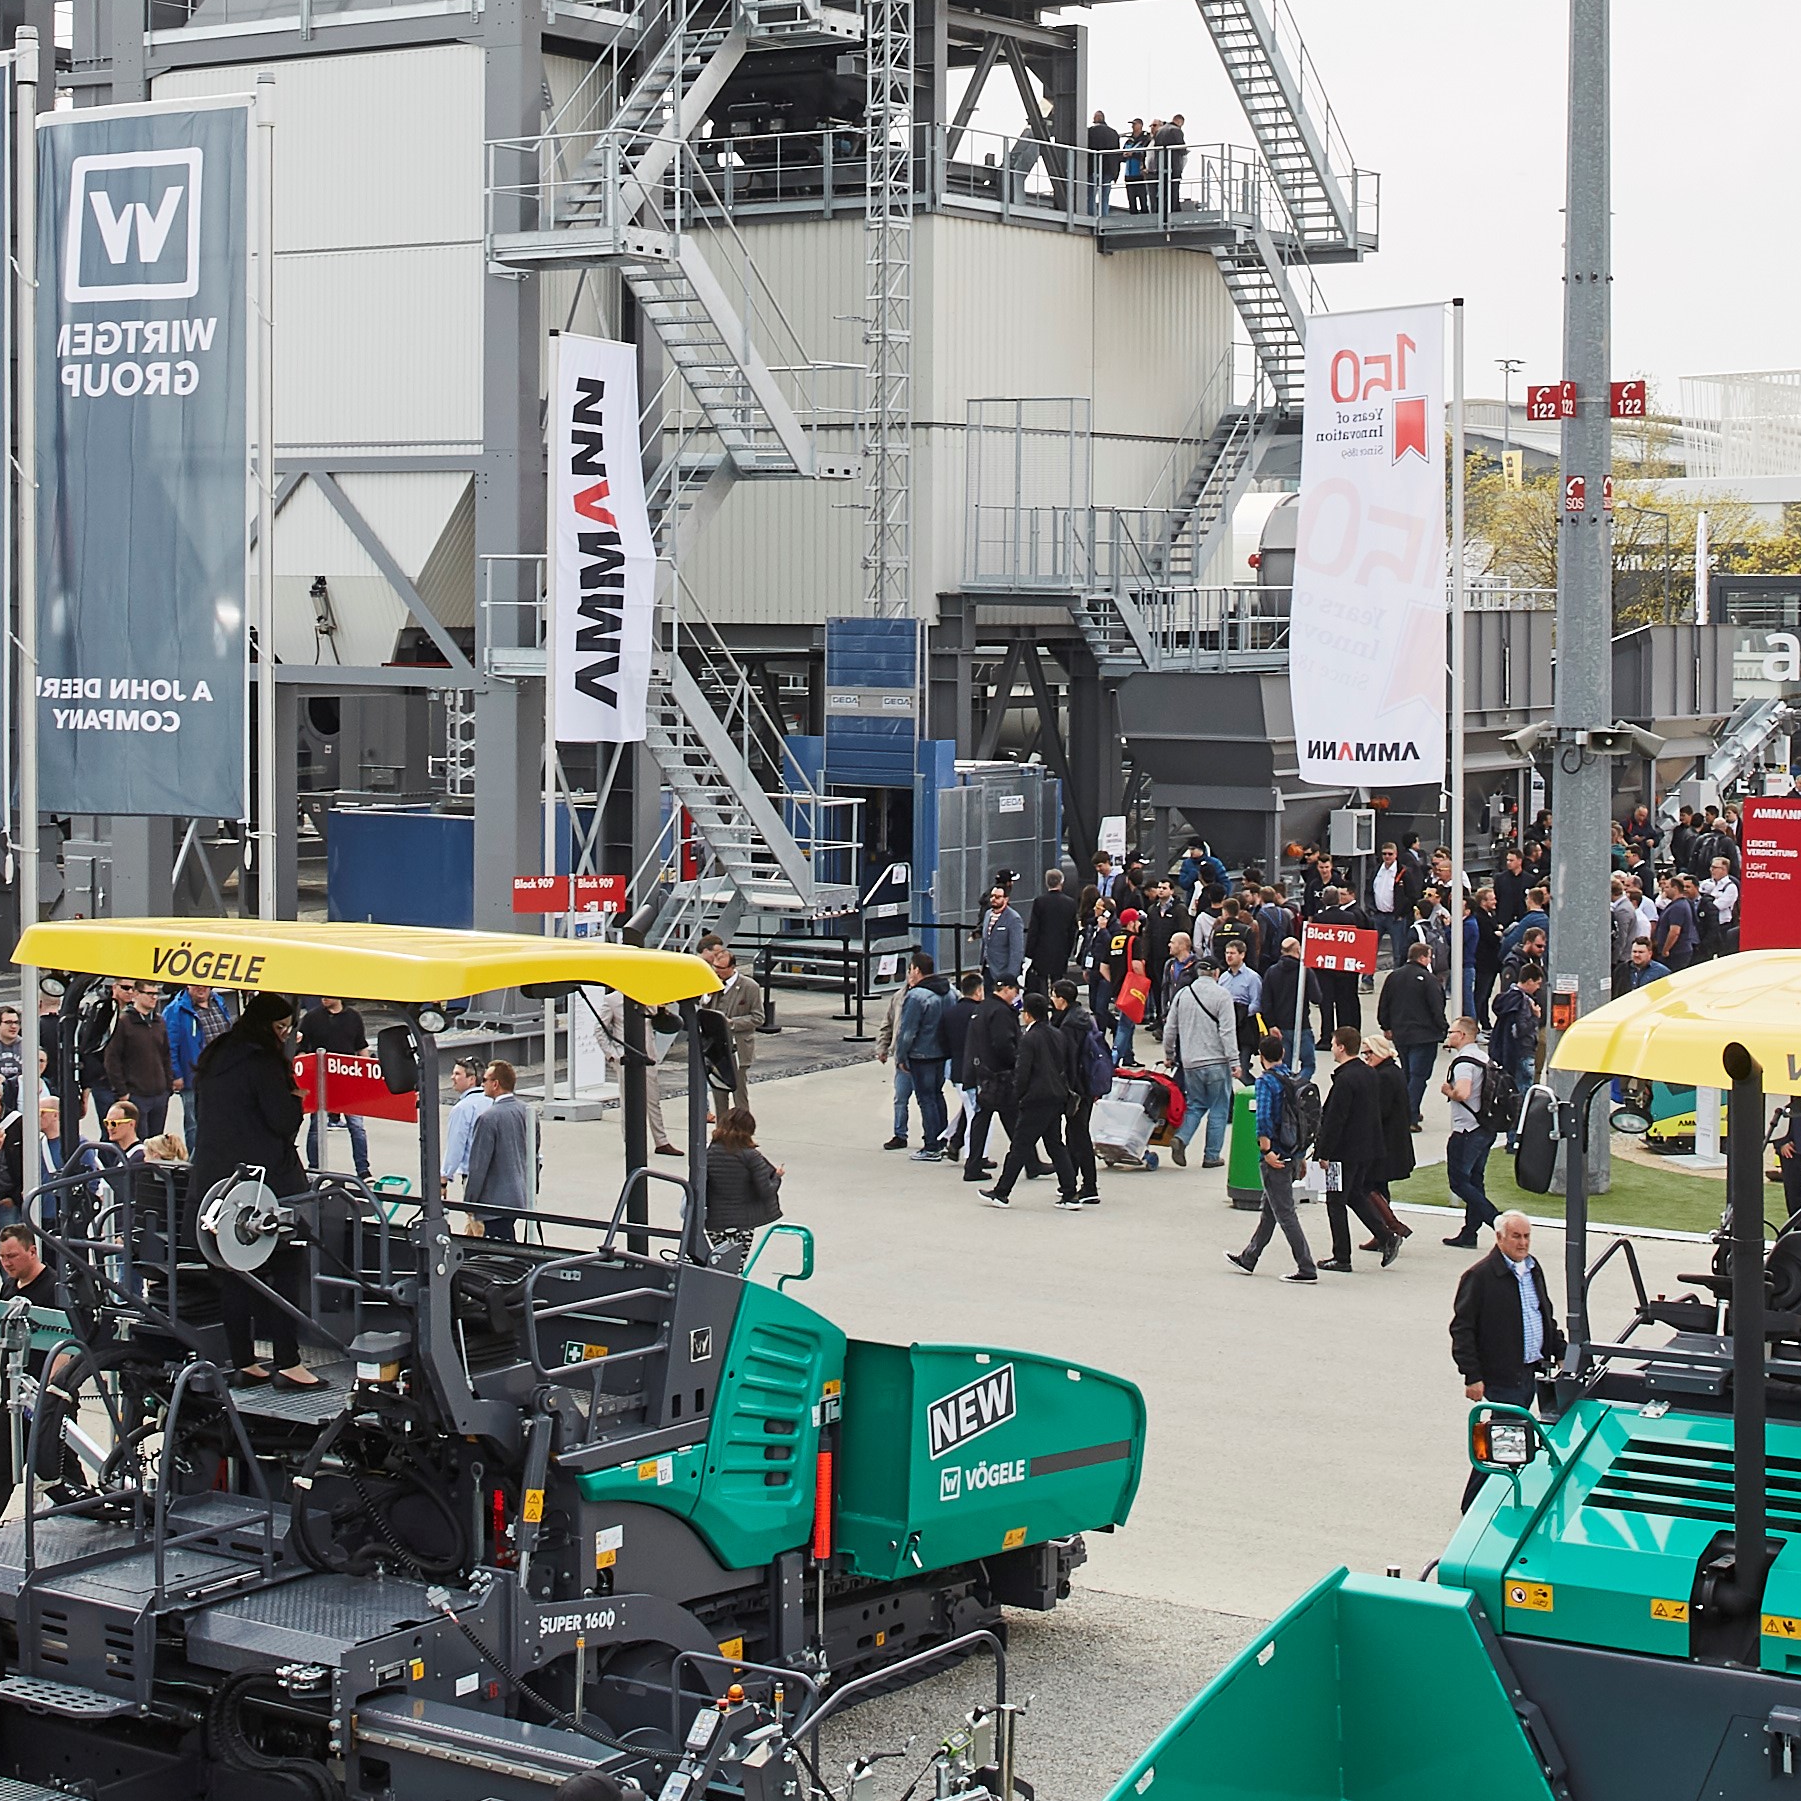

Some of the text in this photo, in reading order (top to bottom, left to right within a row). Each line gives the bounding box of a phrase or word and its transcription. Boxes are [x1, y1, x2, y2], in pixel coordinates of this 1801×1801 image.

[1531, 403, 1556, 419] 122
[1561, 400, 1574, 417] 122
[1617, 399, 1641, 416] 122
[1565, 496, 1585, 510] SOS
[572, 377, 625, 709] AMMANN
[832, 696, 857, 704] GEDA
[884, 697, 909, 706] GEDA
[1747, 840, 1777, 848] LEICHTE
[1747, 849, 1798, 858] VERDICHTUNG
[1747, 863, 1767, 871] LIGHT
[514, 877, 554, 889] Block 909
[578, 877, 614, 889] Block 909
[1746, 872, 1791, 881] COMPACTION
[1307, 927, 1356, 944] Block 910
[153, 942, 266, 983] VÖGELE
[328, 1058, 362, 1077] Block
[933, 1372, 1010, 1452] NEW
[965, 1459, 1026, 1491] VÖGELE
[539, 1610, 616, 1635] SUPER 1600
